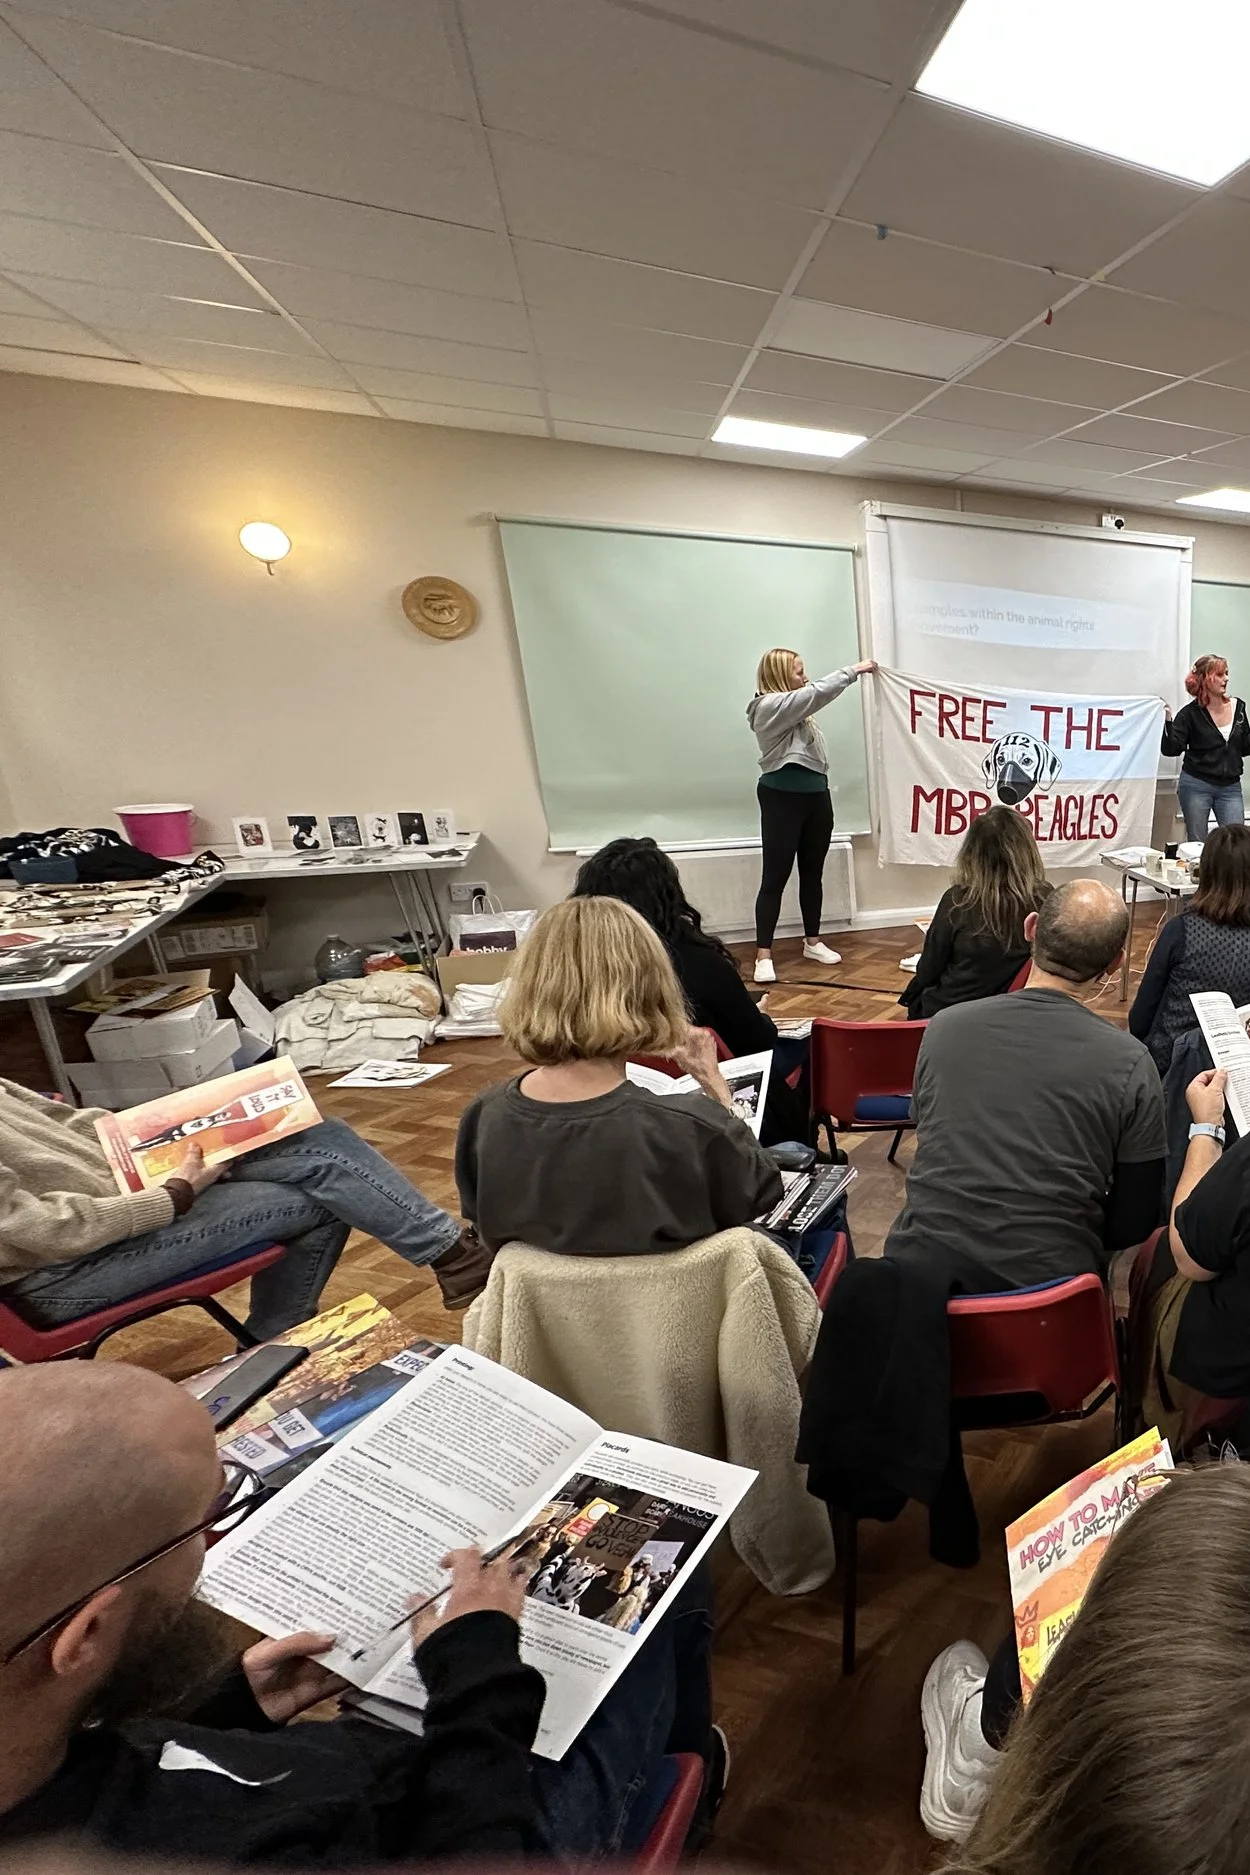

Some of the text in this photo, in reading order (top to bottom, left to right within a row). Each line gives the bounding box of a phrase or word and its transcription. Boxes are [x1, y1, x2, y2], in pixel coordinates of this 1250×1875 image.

[969, 605, 1004, 621] within
[1006, 611, 1025, 624] the
[1027, 615, 1063, 628] animal
[909, 689, 1124, 751] FREE THE
[1002, 736, 1031, 749] 112
[394, 1354, 430, 1371] EXPEC
[601, 1441, 630, 1454] Placards
[602, 1512, 650, 1537] STOP
[585, 1534, 609, 1550] GO
[1019, 1520, 1066, 1570] HOW
[1068, 1503, 1098, 1532] TO
[1037, 1544, 1067, 1573] EYE
